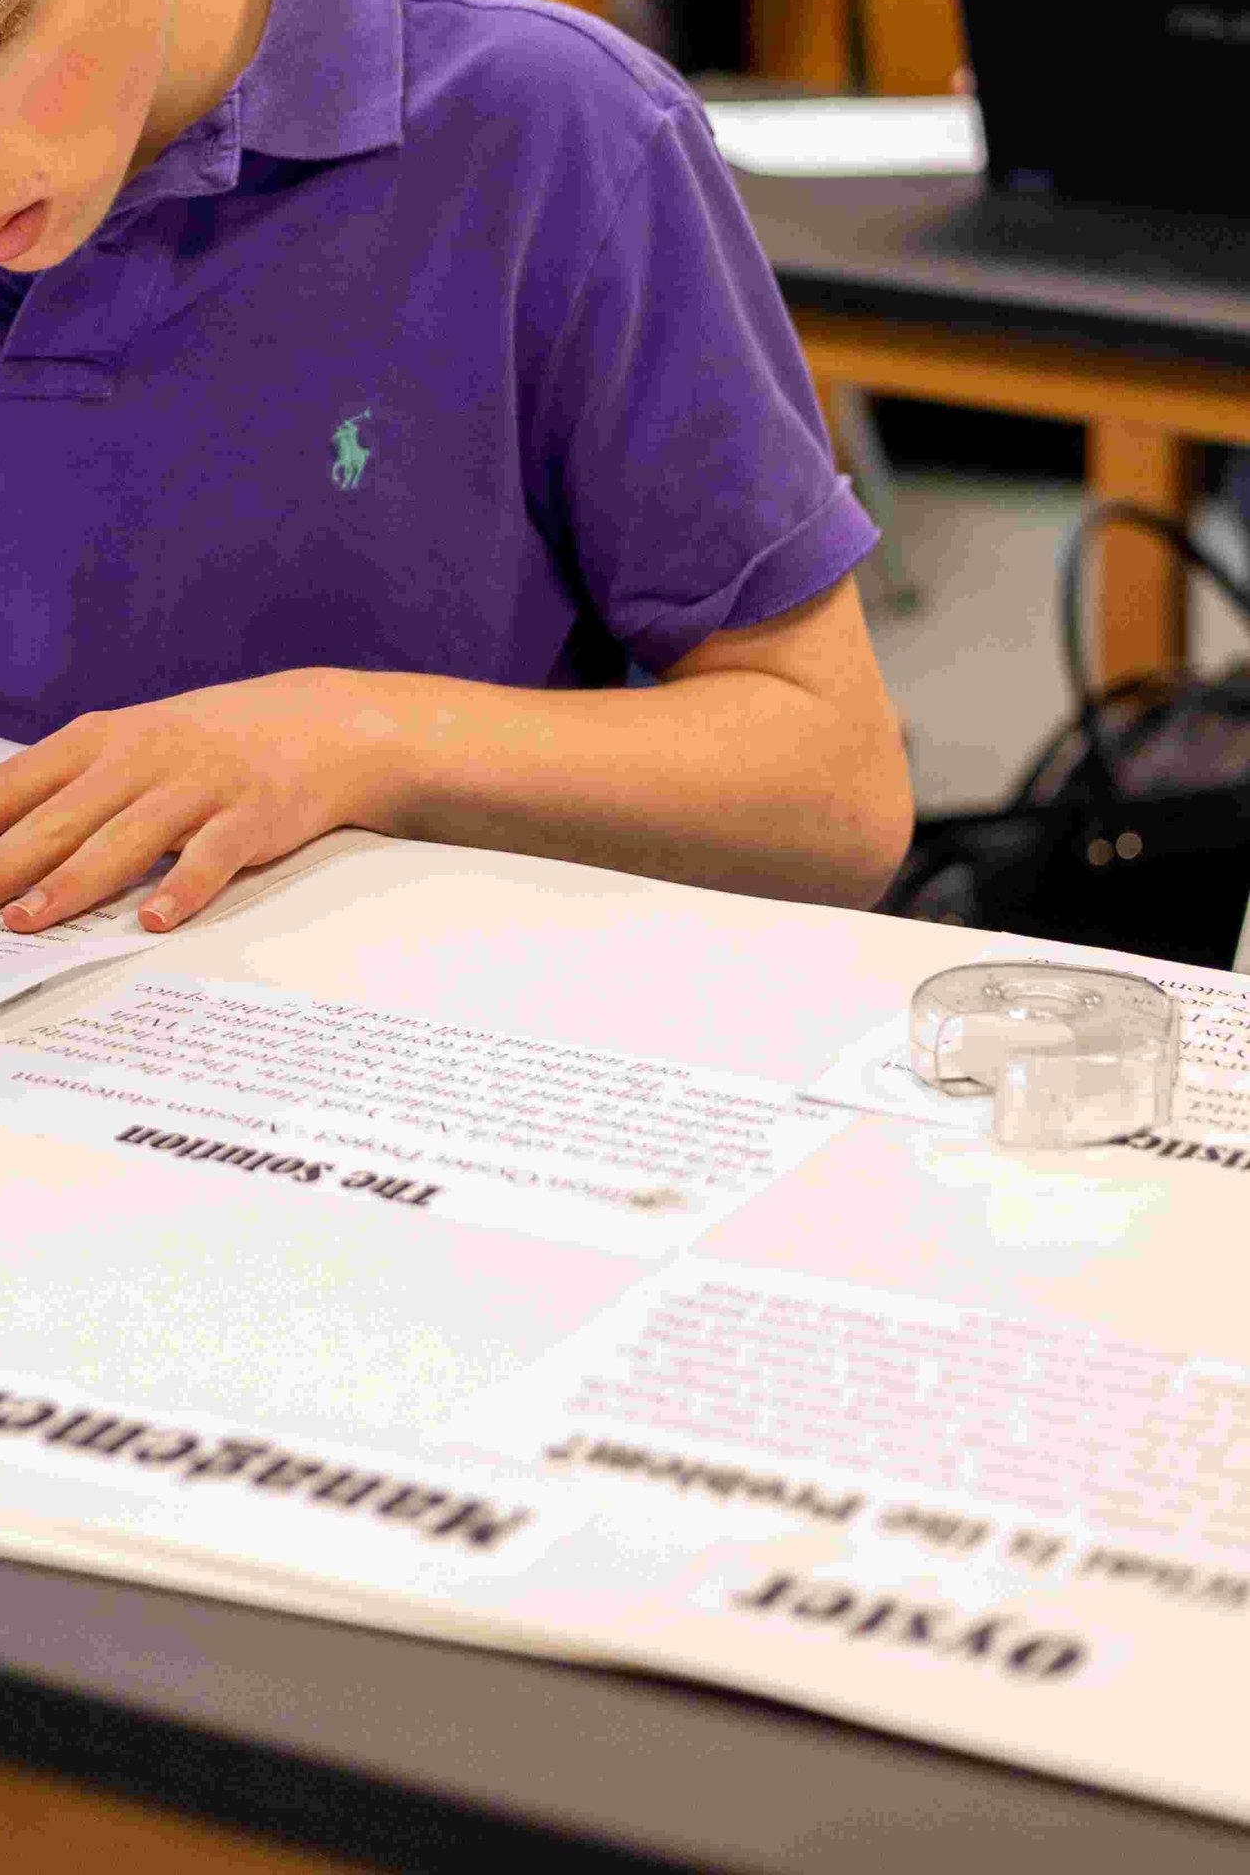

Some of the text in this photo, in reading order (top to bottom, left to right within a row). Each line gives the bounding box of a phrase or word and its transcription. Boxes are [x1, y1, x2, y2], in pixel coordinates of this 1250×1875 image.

[136, 992, 192, 1013] and
[211, 1000, 301, 1018] public
[61, 1018, 157, 1040] helped
[111, 1008, 177, 1029] With
[353, 1012, 430, 1027] cared
[29, 1026, 185, 1058] community
[158, 1028, 221, 1053] have
[222, 1032, 286, 1048] from
[304, 1016, 453, 1048] world-class
[433, 1026, 493, 1040] well
[44, 1046, 124, 1063] center
[496, 1039, 555, 1051] and
[189, 1058, 237, 1072] The
[226, 1049, 363, 1078] ecosystem
[290, 1045, 383, 1069] benefit
[429, 1058, 462, 1066] for
[488, 1052, 508, 1060] is
[555, 1050, 624, 1065] used
[129, 1063, 172, 1075] the
[179, 1072, 203, 1084] is
[391, 1064, 479, 1085] return
[518, 1059, 606, 1080] harbor
[627, 1063, 690, 1078] well
[11, 1072, 160, 1105] statement
[208, 1079, 308, 1103] Harbor
[167, 1102, 284, 1134] Mission
[114, 1125, 442, 1210] The Solution
[544, 1435, 864, 1525] Problem?
[880, 1505, 991, 1552] the
[732, 1576, 1085, 1679] Oyster
